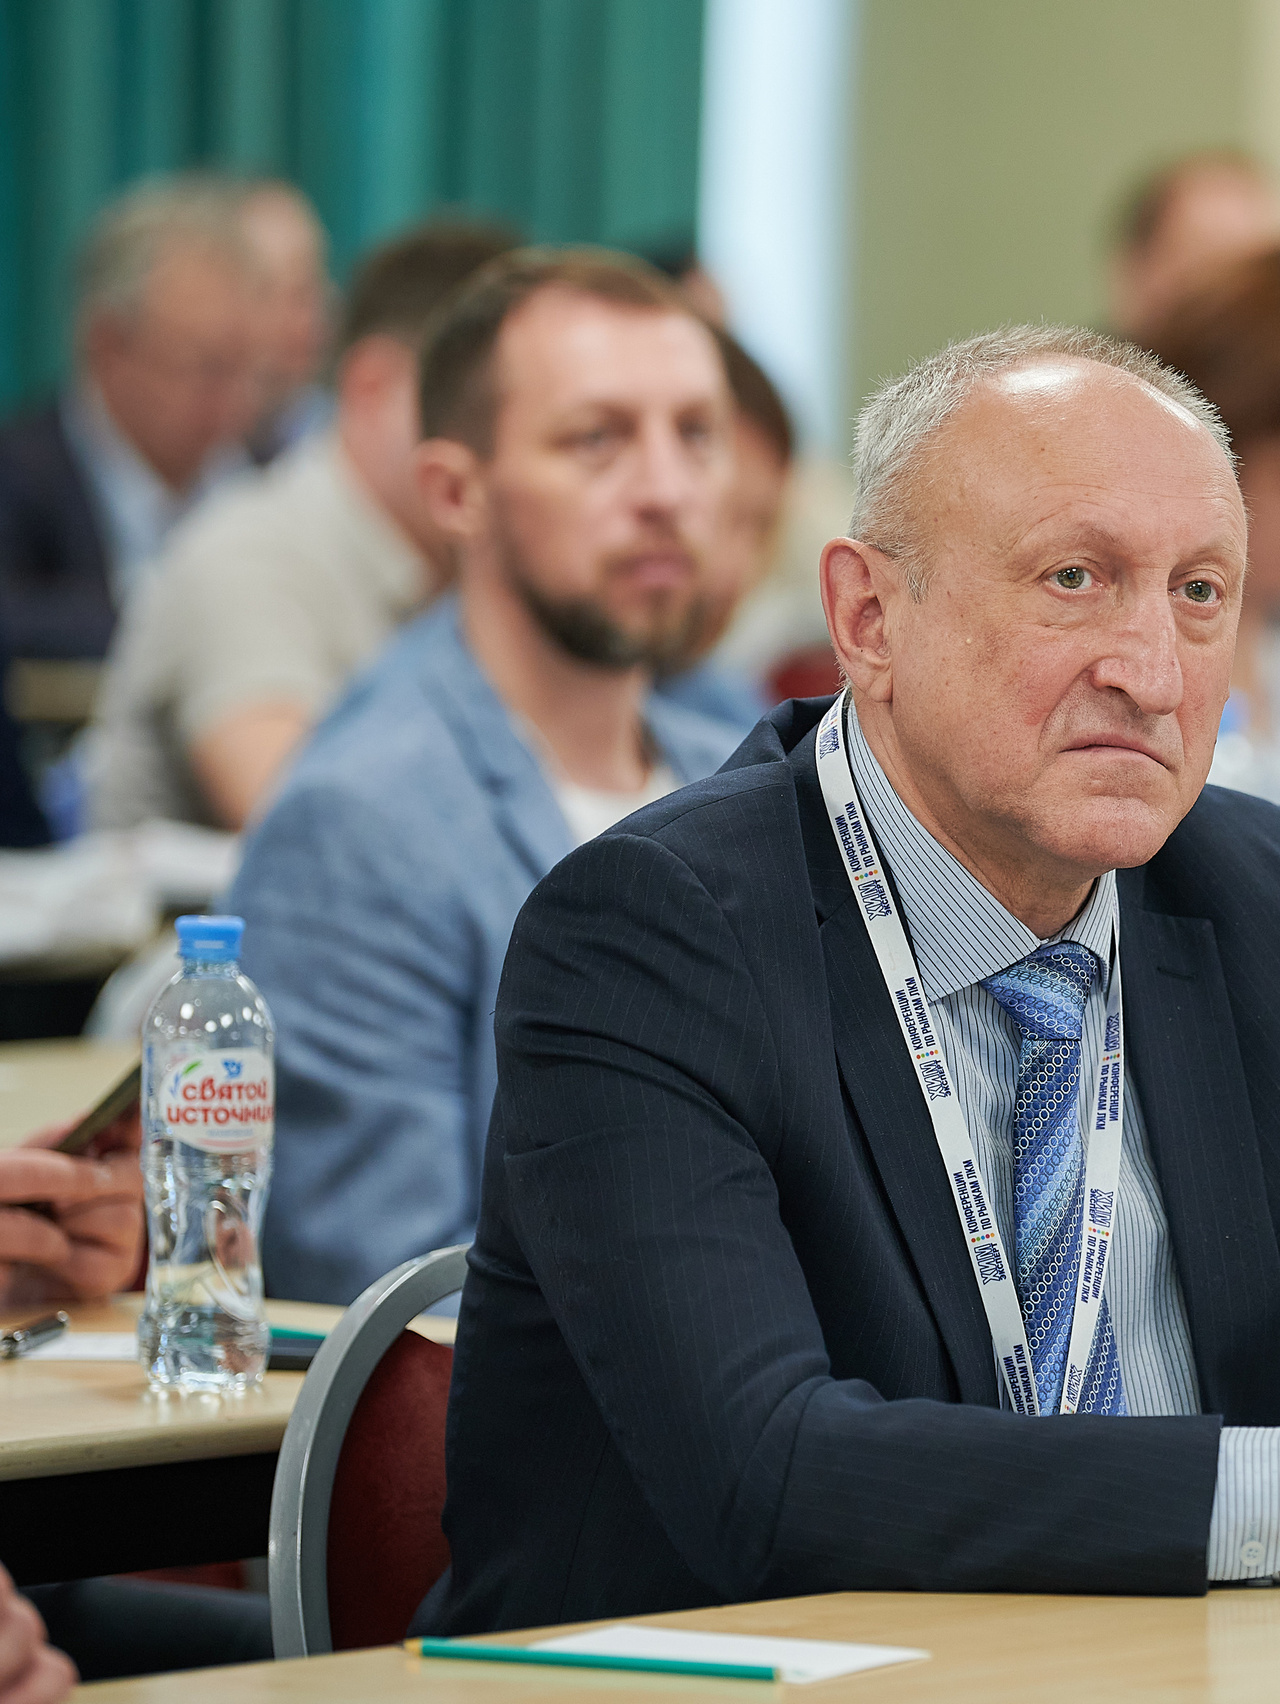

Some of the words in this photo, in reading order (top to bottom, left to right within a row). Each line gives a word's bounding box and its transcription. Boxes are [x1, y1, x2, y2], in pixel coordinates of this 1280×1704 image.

[844, 800, 859, 820] ЛКМ
[834, 814, 862, 872] КОНФЕРЕНЦИИ
[850, 819, 871, 856] РЫНКАМ
[862, 854, 875, 868] ПО
[857, 879, 887, 921] ХИМ
[873, 879, 892, 916] ЭКСПЕРТ
[904, 976, 920, 999] ЛКМ
[894, 989, 924, 1051] КОНФЕРЕНЦИИ
[911, 997, 932, 1035] РЫНКАМ
[1107, 1012, 1120, 1052] ХИМ
[924, 1034, 936, 1047] ПО
[919, 1059, 947, 1101] ХИМ
[933, 1059, 952, 1098] ЭКСПЕРТ
[1100, 1064, 1110, 1076] ПО
[1097, 1075, 1109, 1111] РЫНКАМ
[1109, 1062, 1120, 1122] КОНФЕРЕНЦИИ
[1095, 1112, 1107, 1131] ЛКМ
[962, 1159, 977, 1179] ЛКМ
[952, 1171, 980, 1234] КОНФЕРЕНЦИИ
[969, 1179, 988, 1218] РЫНКАМ
[1088, 1188, 1098, 1224] ЭКСПЕРТ
[1094, 1188, 1114, 1228] ХИМ
[980, 1217, 993, 1231] ПО
[1087, 1234, 1097, 1248] ПО
[973, 1243, 1001, 1285] ХИМ
[990, 1242, 1007, 1281] ЭКСПЕРТ
[1083, 1247, 1096, 1284] РЫНКАМ
[1091, 1238, 1108, 1300] КОНФЕРЕНЦИИ
[1080, 1283, 1090, 1304] ЛКМ
[1013, 1343, 1027, 1364] ЛКМ
[1002, 1355, 1026, 1415] ОНФЕРЕНЦИИ
[1018, 1365, 1034, 1405] РЫНКАМ
[1026, 1403, 1036, 1416] ПО
